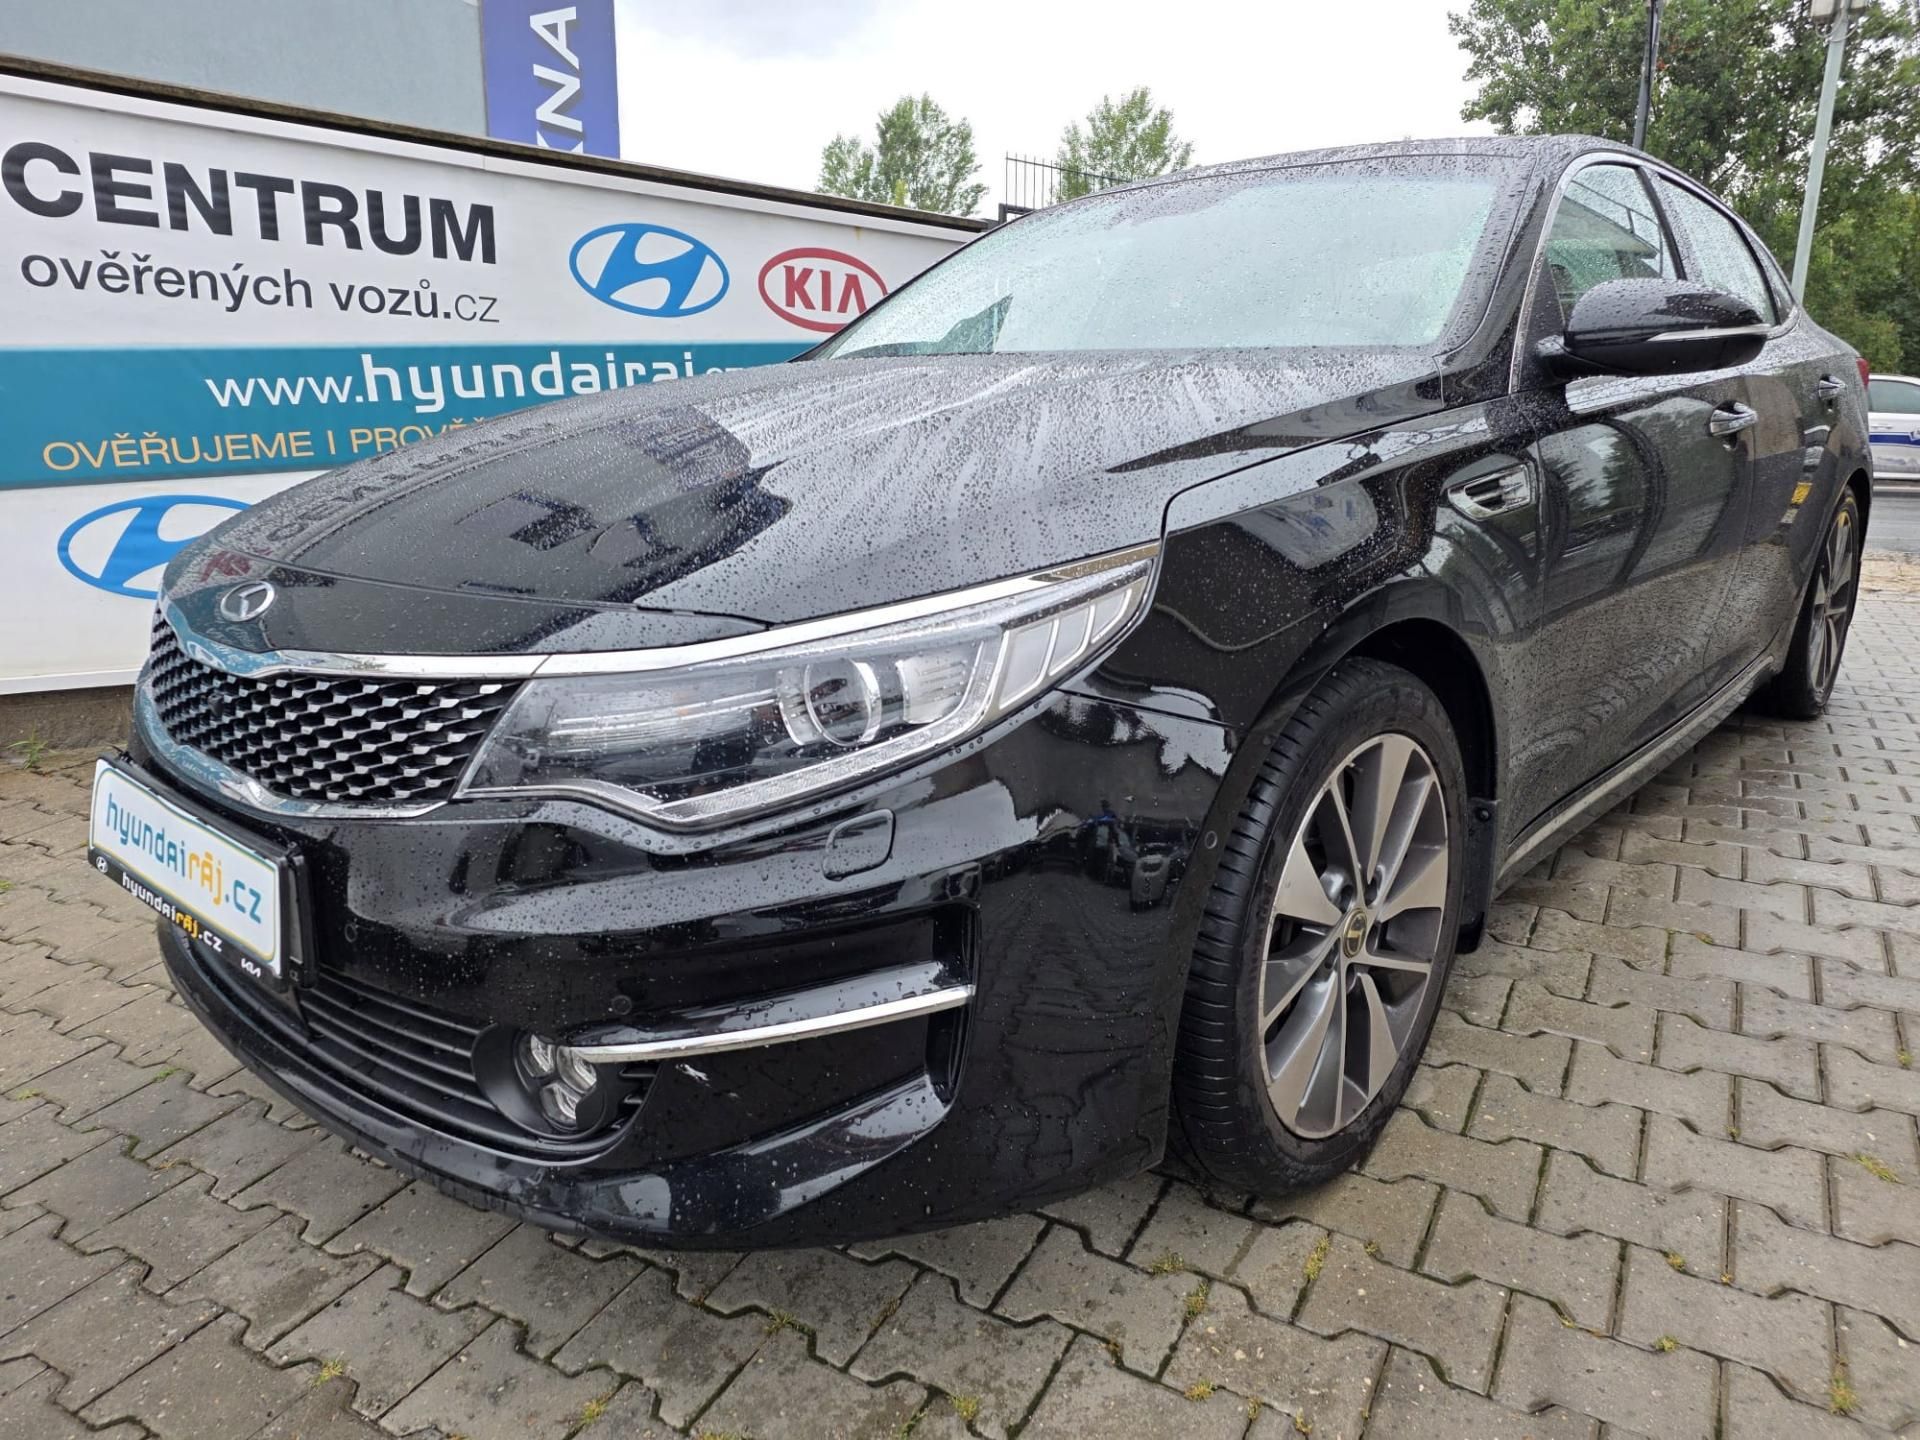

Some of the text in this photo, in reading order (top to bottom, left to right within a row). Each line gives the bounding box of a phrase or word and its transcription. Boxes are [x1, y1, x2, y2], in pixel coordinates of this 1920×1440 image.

[1, 141, 498, 265] CENTRUM
[20, 249, 500, 323] ověřených vozů.cz
[783, 264, 868, 315] KIA
[42, 430, 315, 471] OVĚŘUJEME
